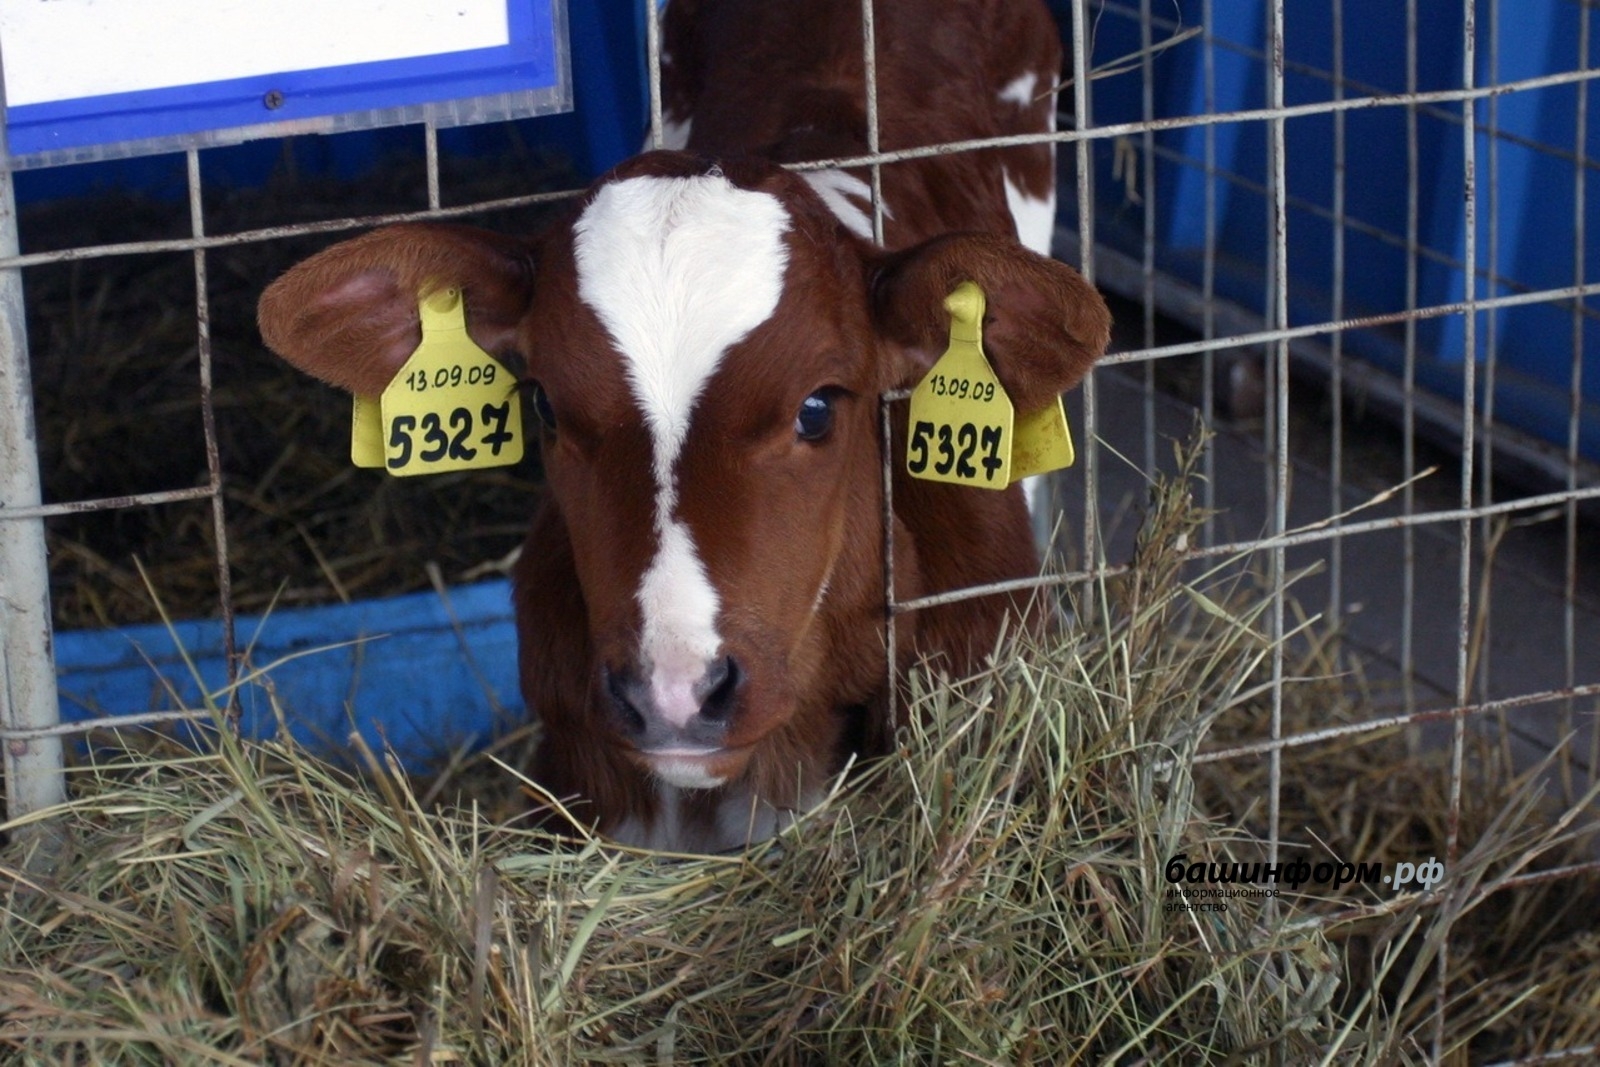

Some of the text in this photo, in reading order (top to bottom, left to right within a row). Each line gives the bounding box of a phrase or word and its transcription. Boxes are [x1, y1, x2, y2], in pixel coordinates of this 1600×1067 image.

[406, 363, 496, 392] 13.09.09
[930, 374, 995, 402] 13.09.09
[387, 400, 513, 469] 5327
[908, 420, 1003, 481] 5327
